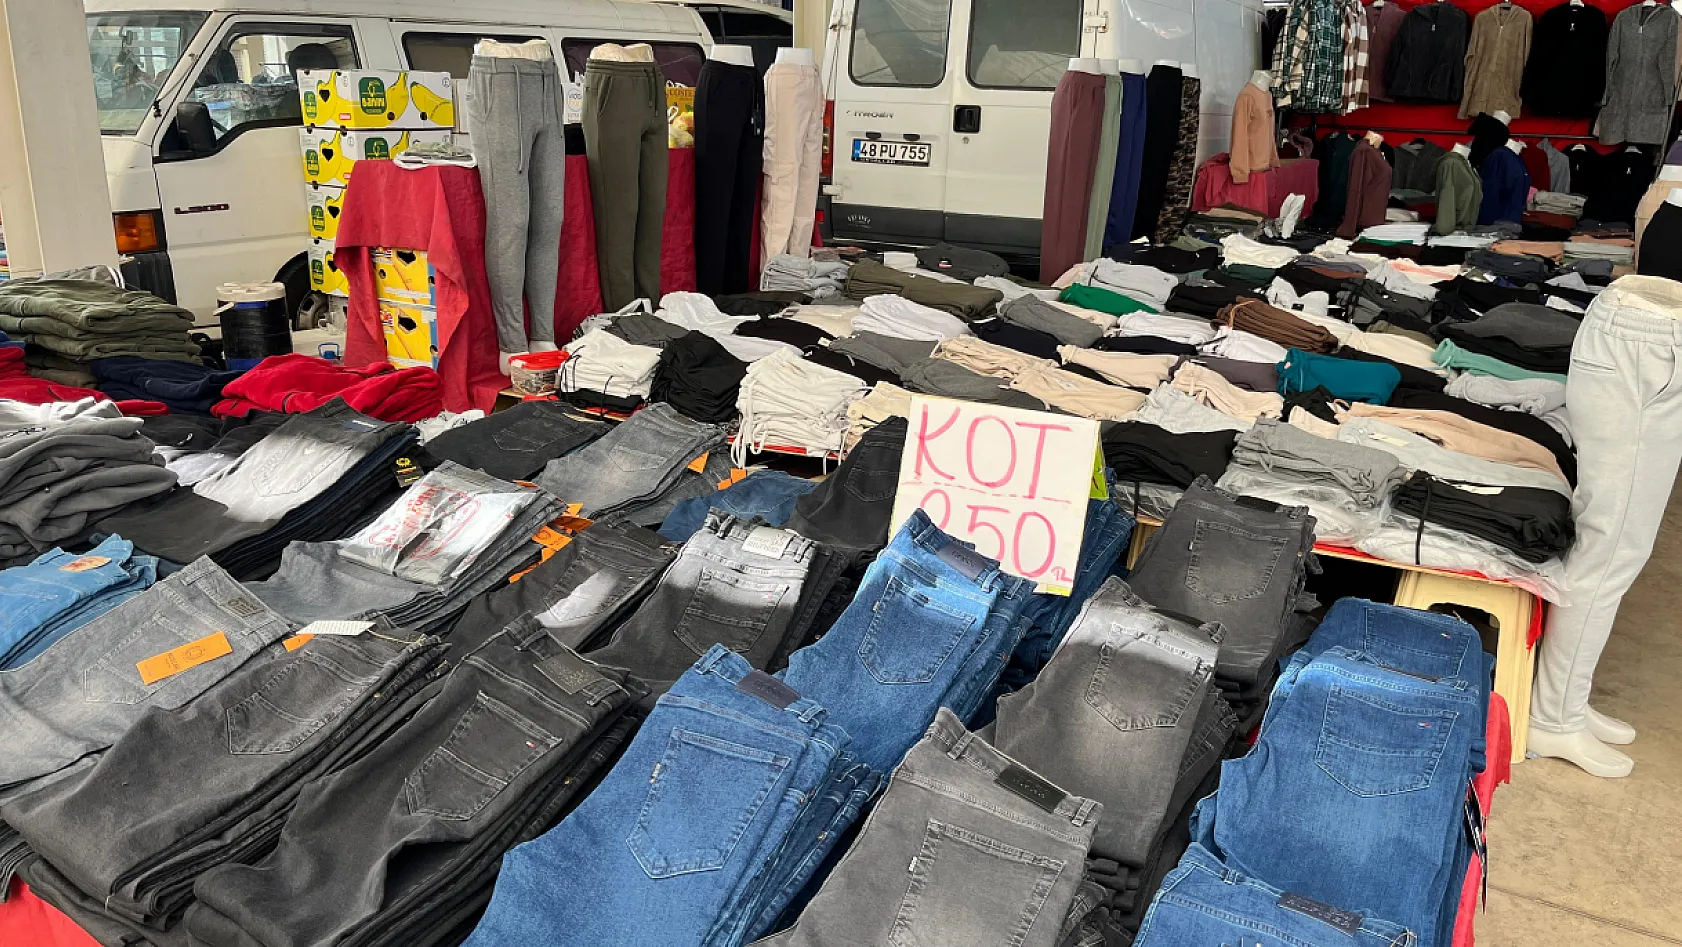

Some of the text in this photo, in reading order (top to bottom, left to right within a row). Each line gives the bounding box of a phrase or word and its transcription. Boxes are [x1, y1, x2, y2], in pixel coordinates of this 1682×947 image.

[860, 143, 877, 157] 48
[880, 144, 897, 158] PU
[900, 145, 927, 161] 755
[913, 403, 1074, 500] KOT
